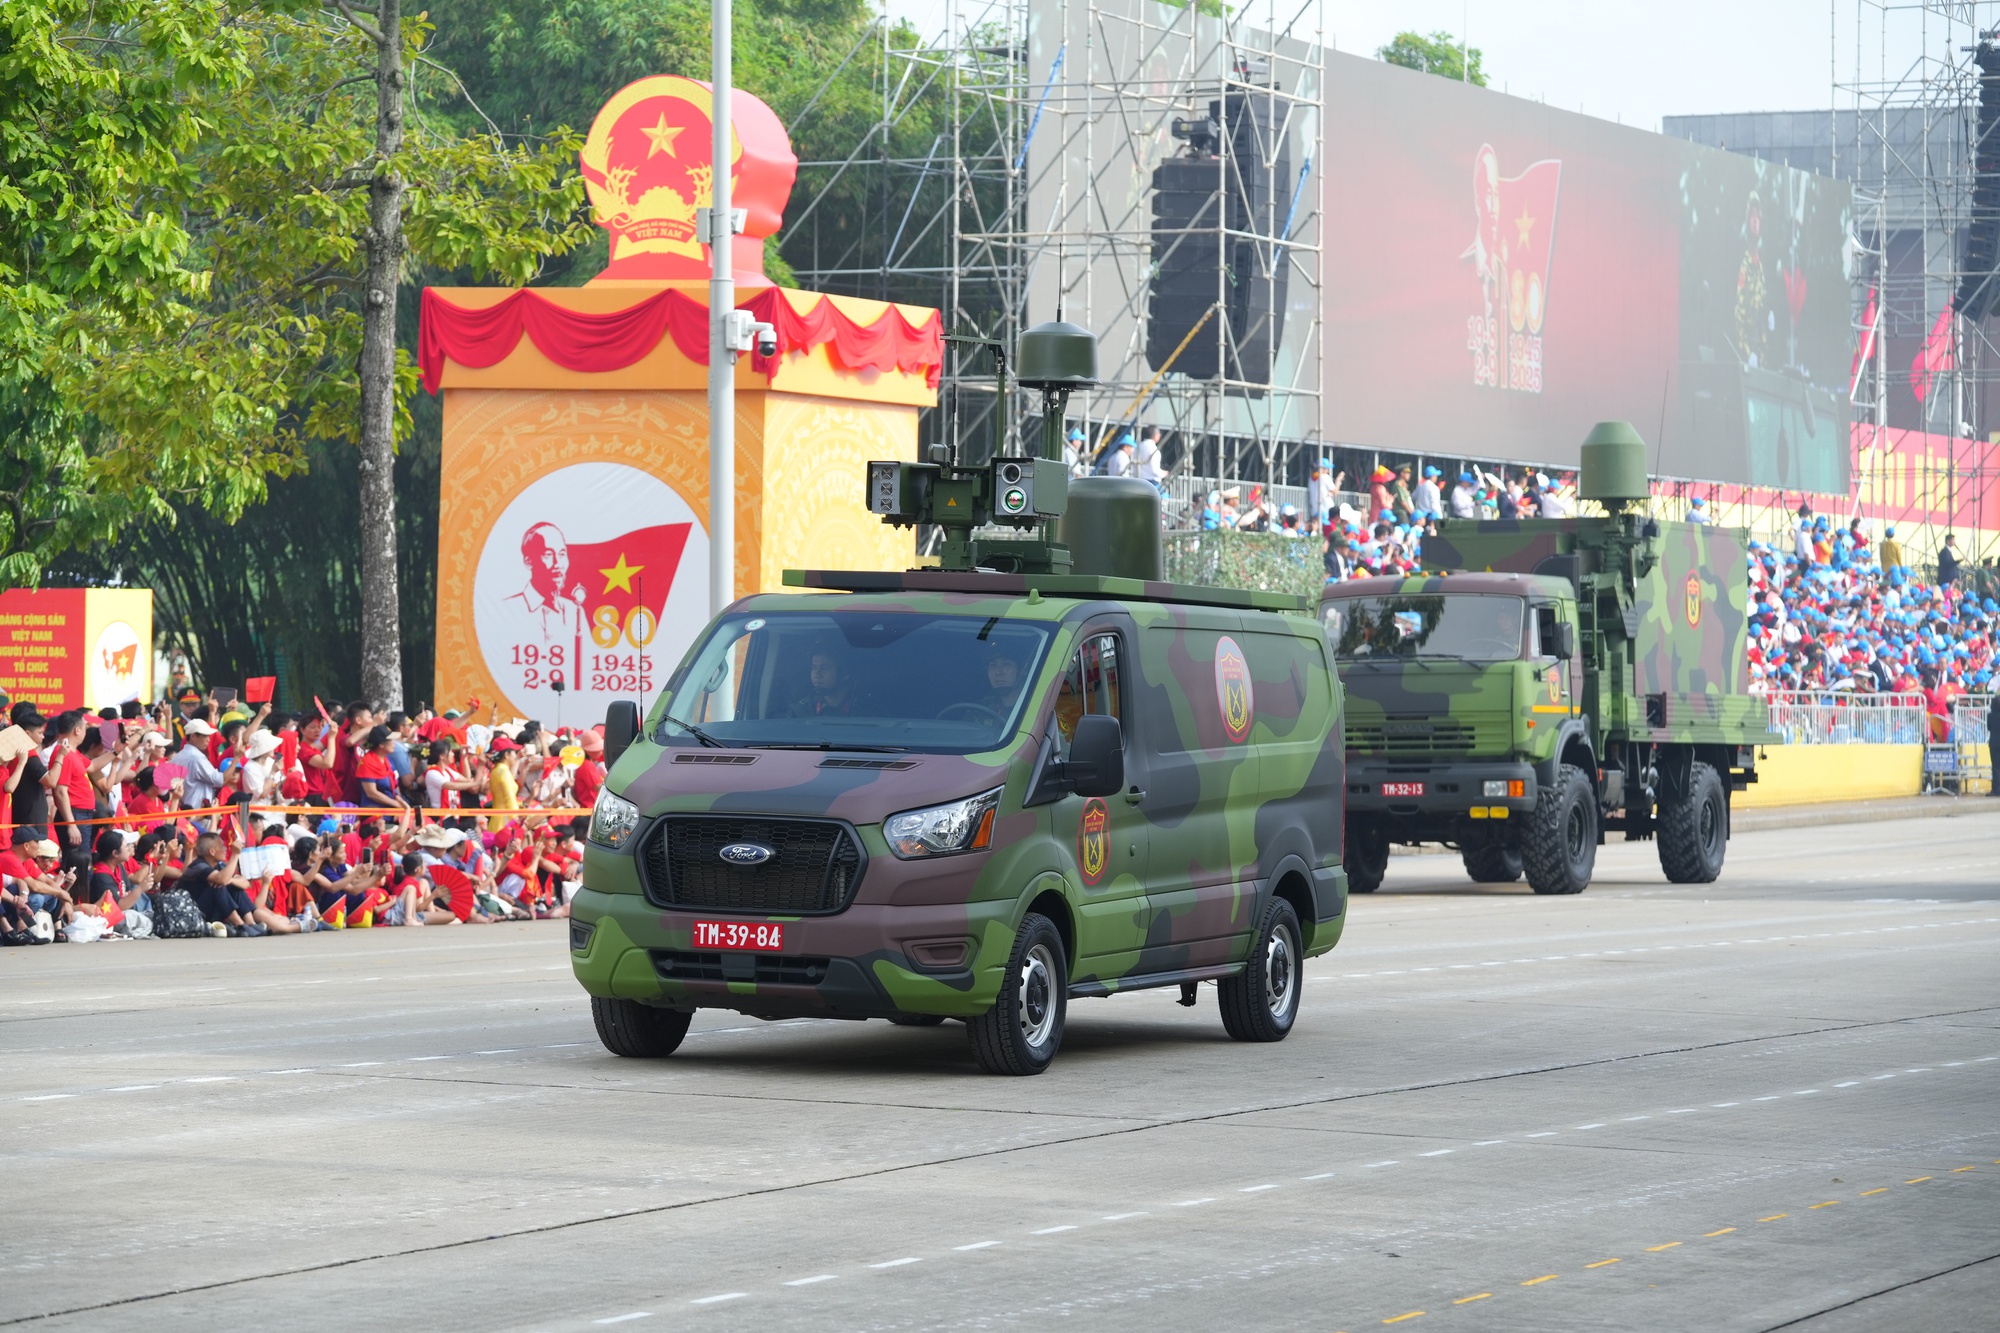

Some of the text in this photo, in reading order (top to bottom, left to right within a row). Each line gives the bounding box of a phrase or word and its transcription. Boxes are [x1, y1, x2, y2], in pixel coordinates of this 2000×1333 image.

[635, 226, 683, 239] VIỆT NAM
[1509, 269, 1544, 334] 80
[1467, 315, 1498, 352] 19-8
[1509, 333, 1543, 363] 1945
[1510, 362, 1543, 393] 2025
[11, 629, 53, 642] VIỆT NAM
[591, 605, 657, 649] 80
[510, 644, 565, 666] 19-8
[592, 655, 653, 672] 1945
[523, 669, 565, 690] 2-9
[591, 675, 653, 692] 2025
[1383, 783, 1424, 795] TM-32-13
[729, 846, 758, 860] Ford
[697, 923, 780, 948] TM-39-84
